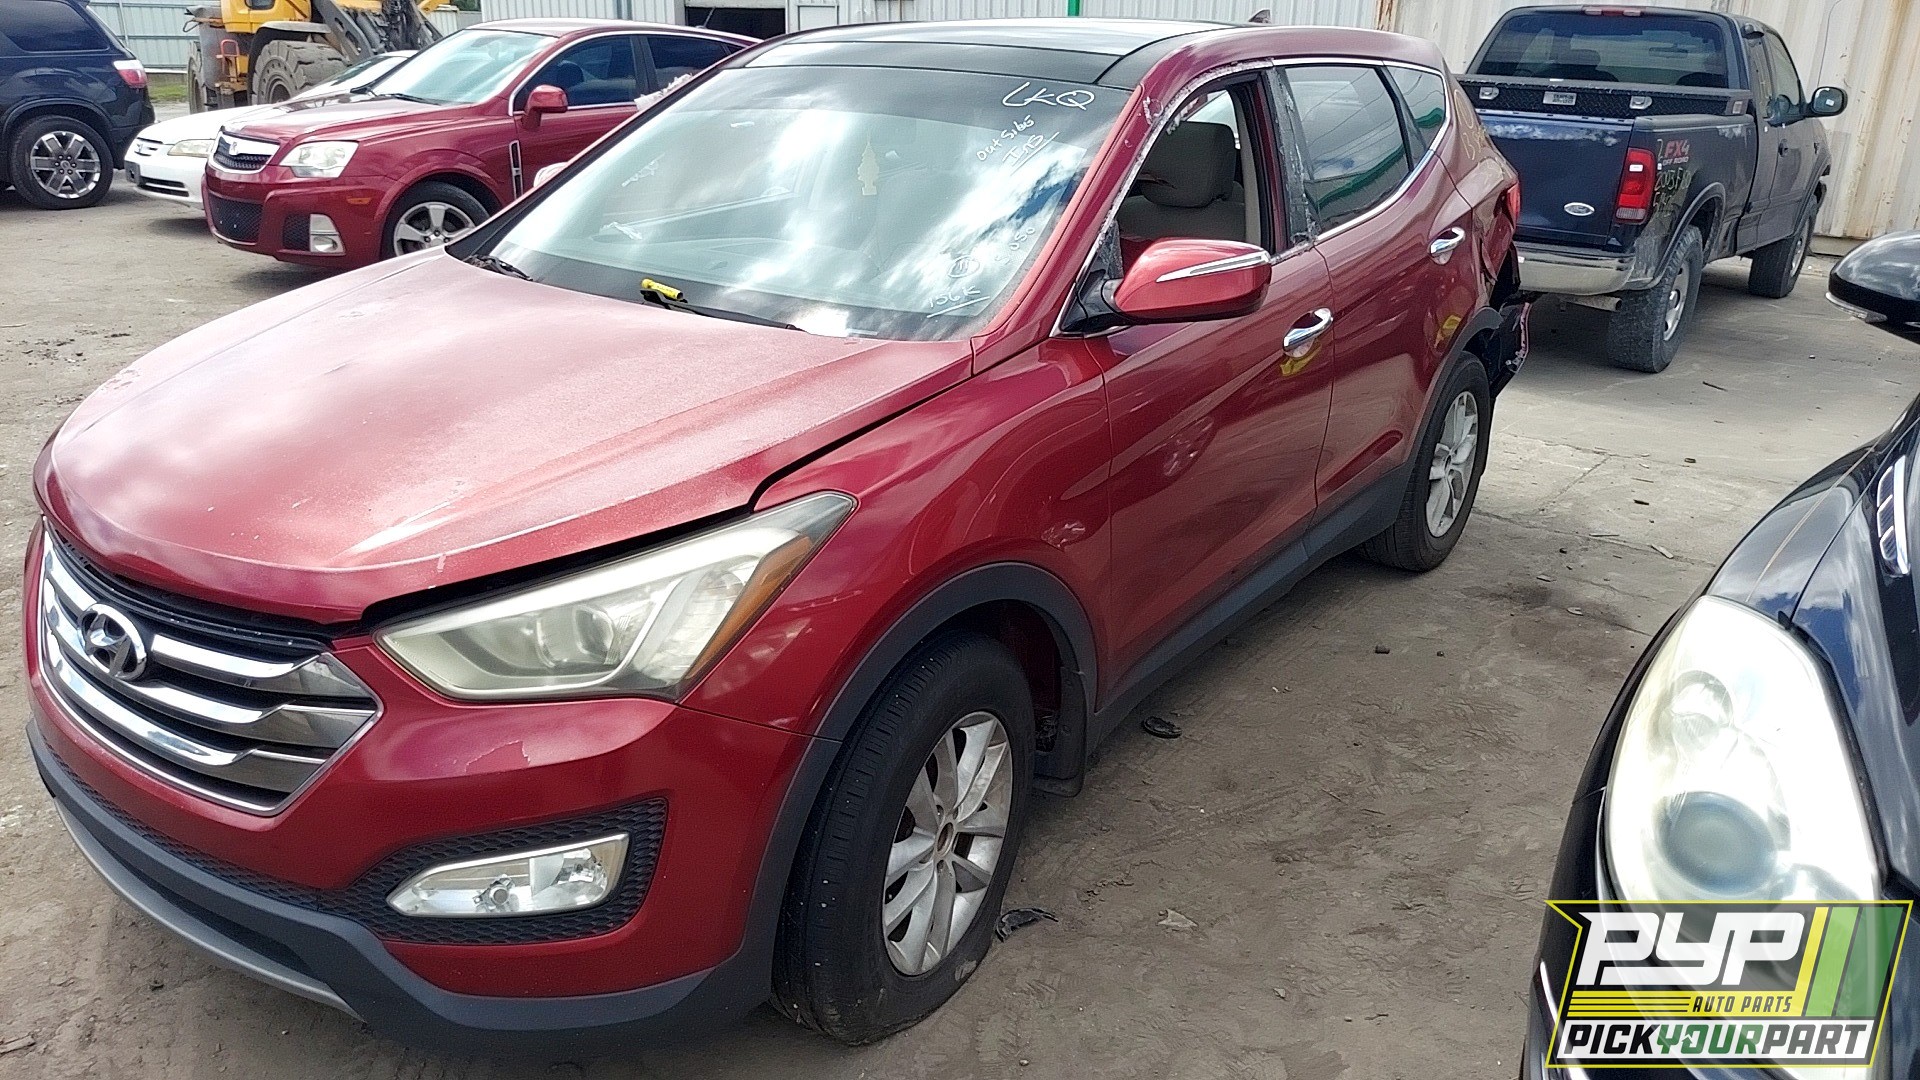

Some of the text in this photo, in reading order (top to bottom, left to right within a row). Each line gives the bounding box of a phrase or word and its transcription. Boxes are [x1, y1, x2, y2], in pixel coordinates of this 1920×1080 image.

[1002, 82, 1095, 110] LKQ
[1664, 139, 1691, 158] FX4
[1662, 156, 1690, 166] OFF ROAD
